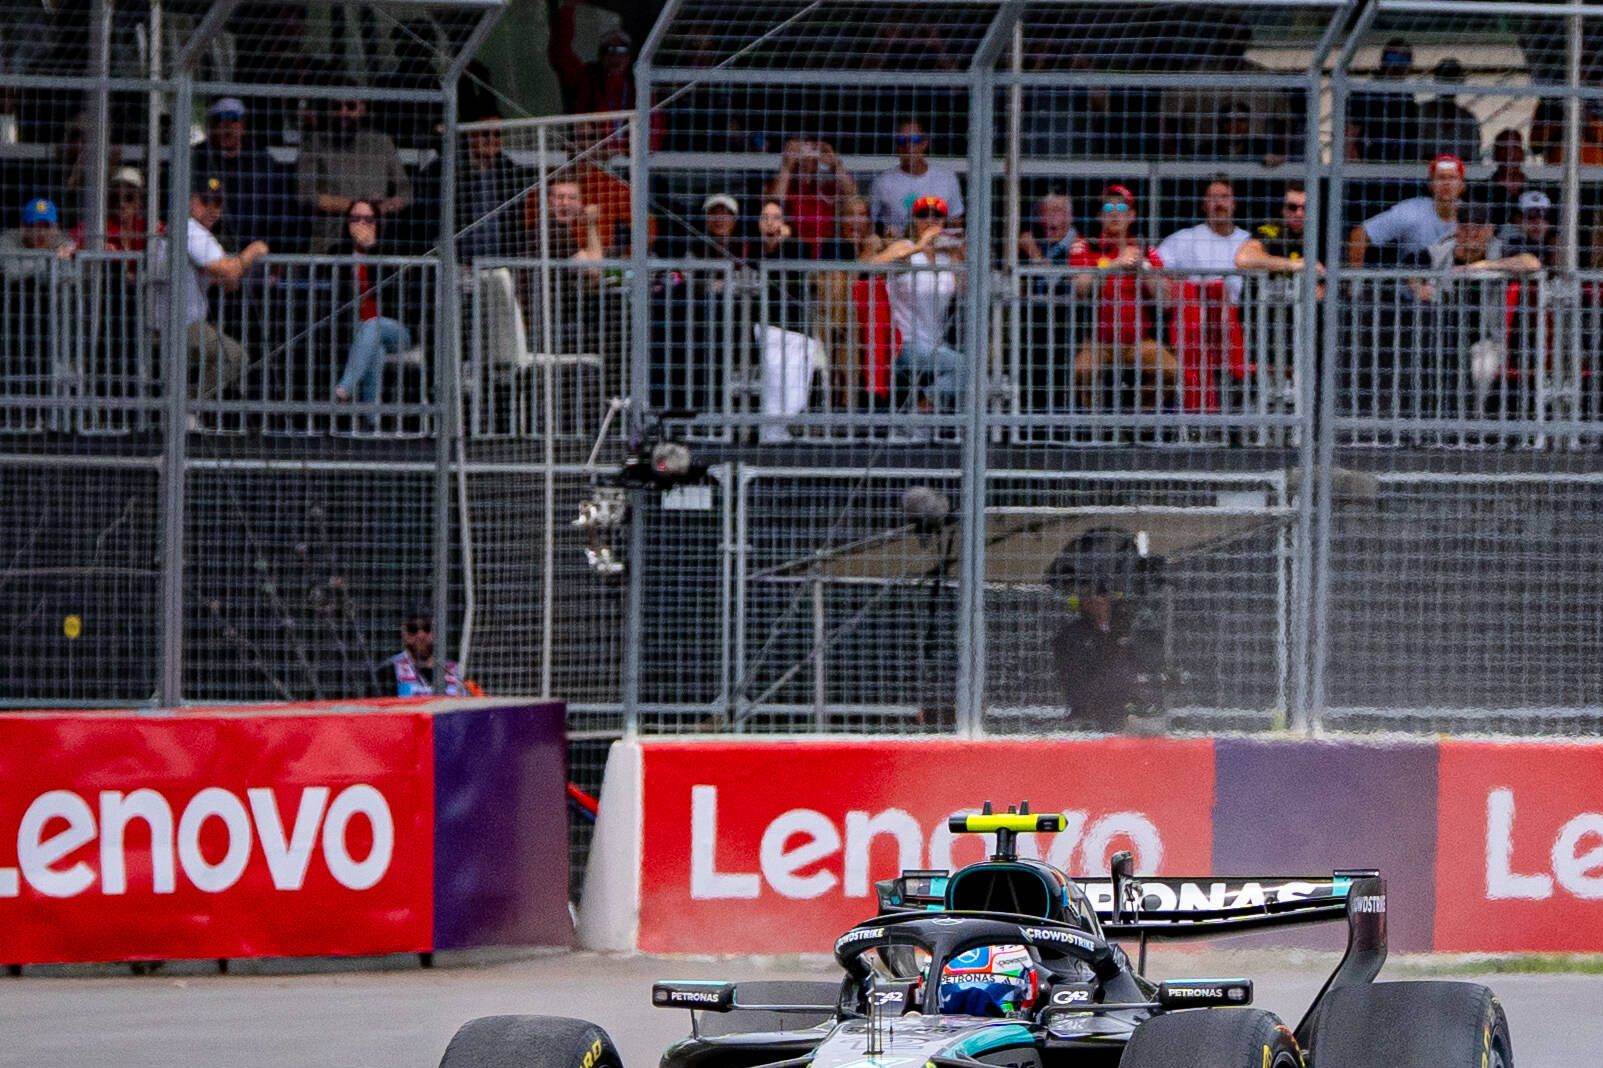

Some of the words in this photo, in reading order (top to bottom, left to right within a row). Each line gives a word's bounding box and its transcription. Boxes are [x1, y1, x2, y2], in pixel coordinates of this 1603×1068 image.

[0, 784, 394, 898] enovo
[1025, 927, 1095, 952] CROWDSTRIKE
[671, 991, 719, 1002] PETRONAS
[1168, 988, 1223, 998] PETRONAS
